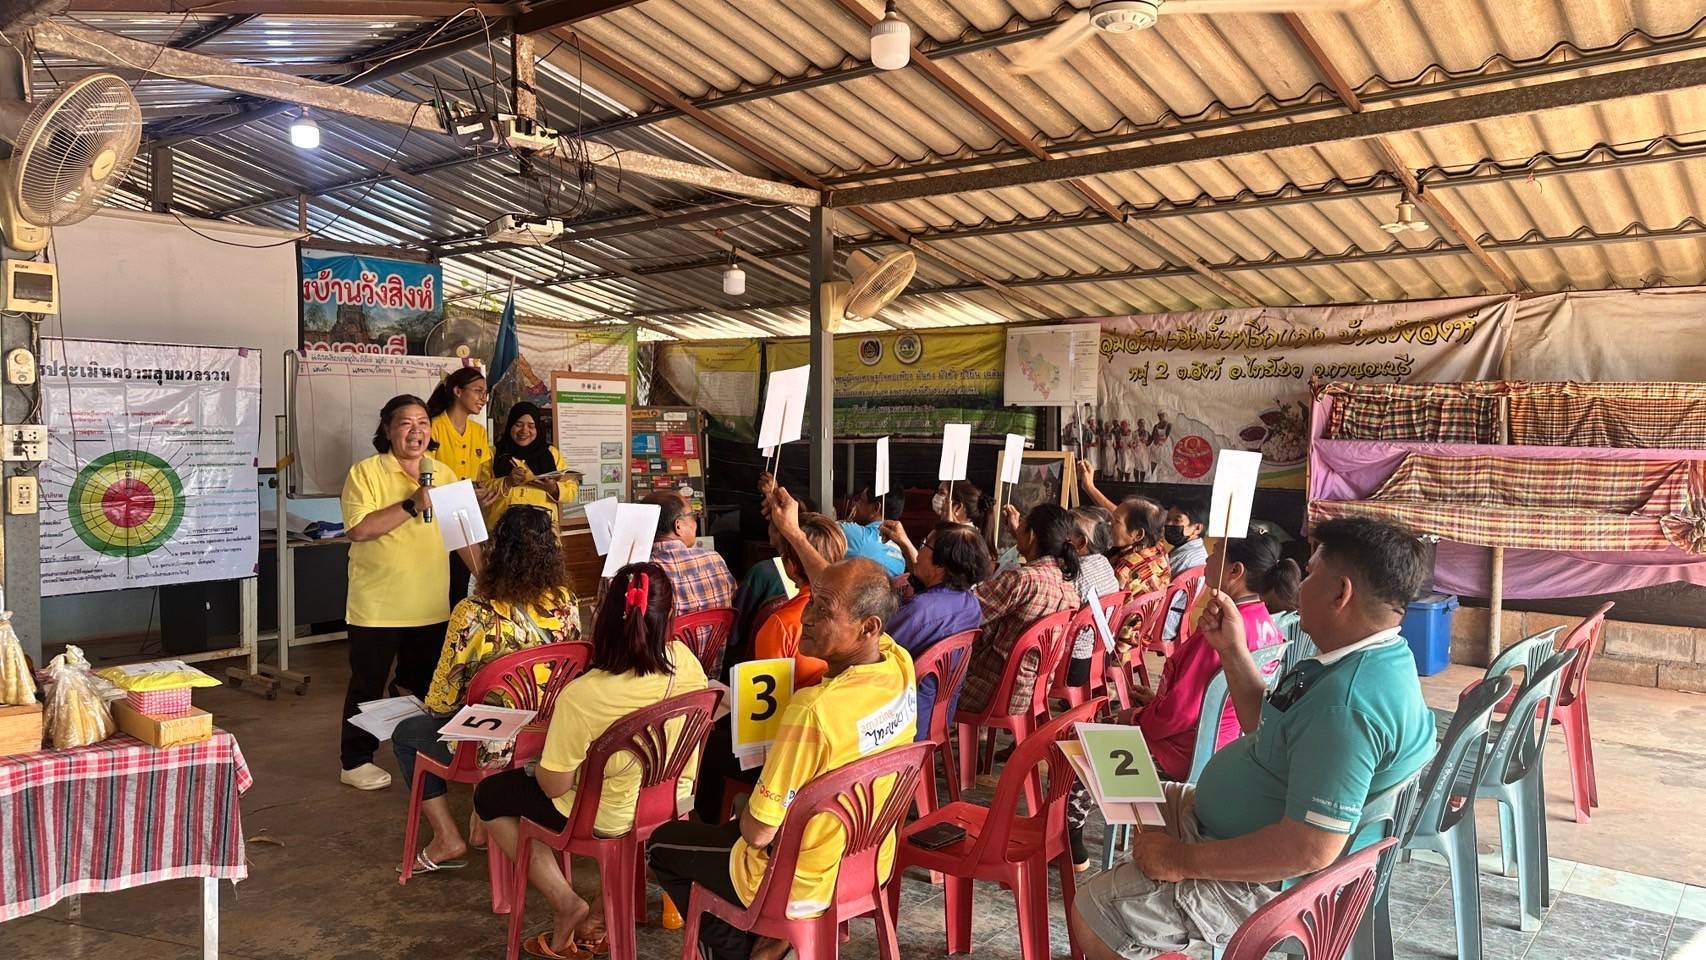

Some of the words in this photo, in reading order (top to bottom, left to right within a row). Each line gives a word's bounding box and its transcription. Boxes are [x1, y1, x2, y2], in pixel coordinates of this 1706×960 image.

[1099, 316, 1325, 363] ลุ่มสัมมาชีพน้ำพริกแกง
[1154, 361, 1170, 380] 2
[750, 674, 777, 721] 3
[462, 715, 503, 731] 5
[1109, 749, 1140, 776] 2
